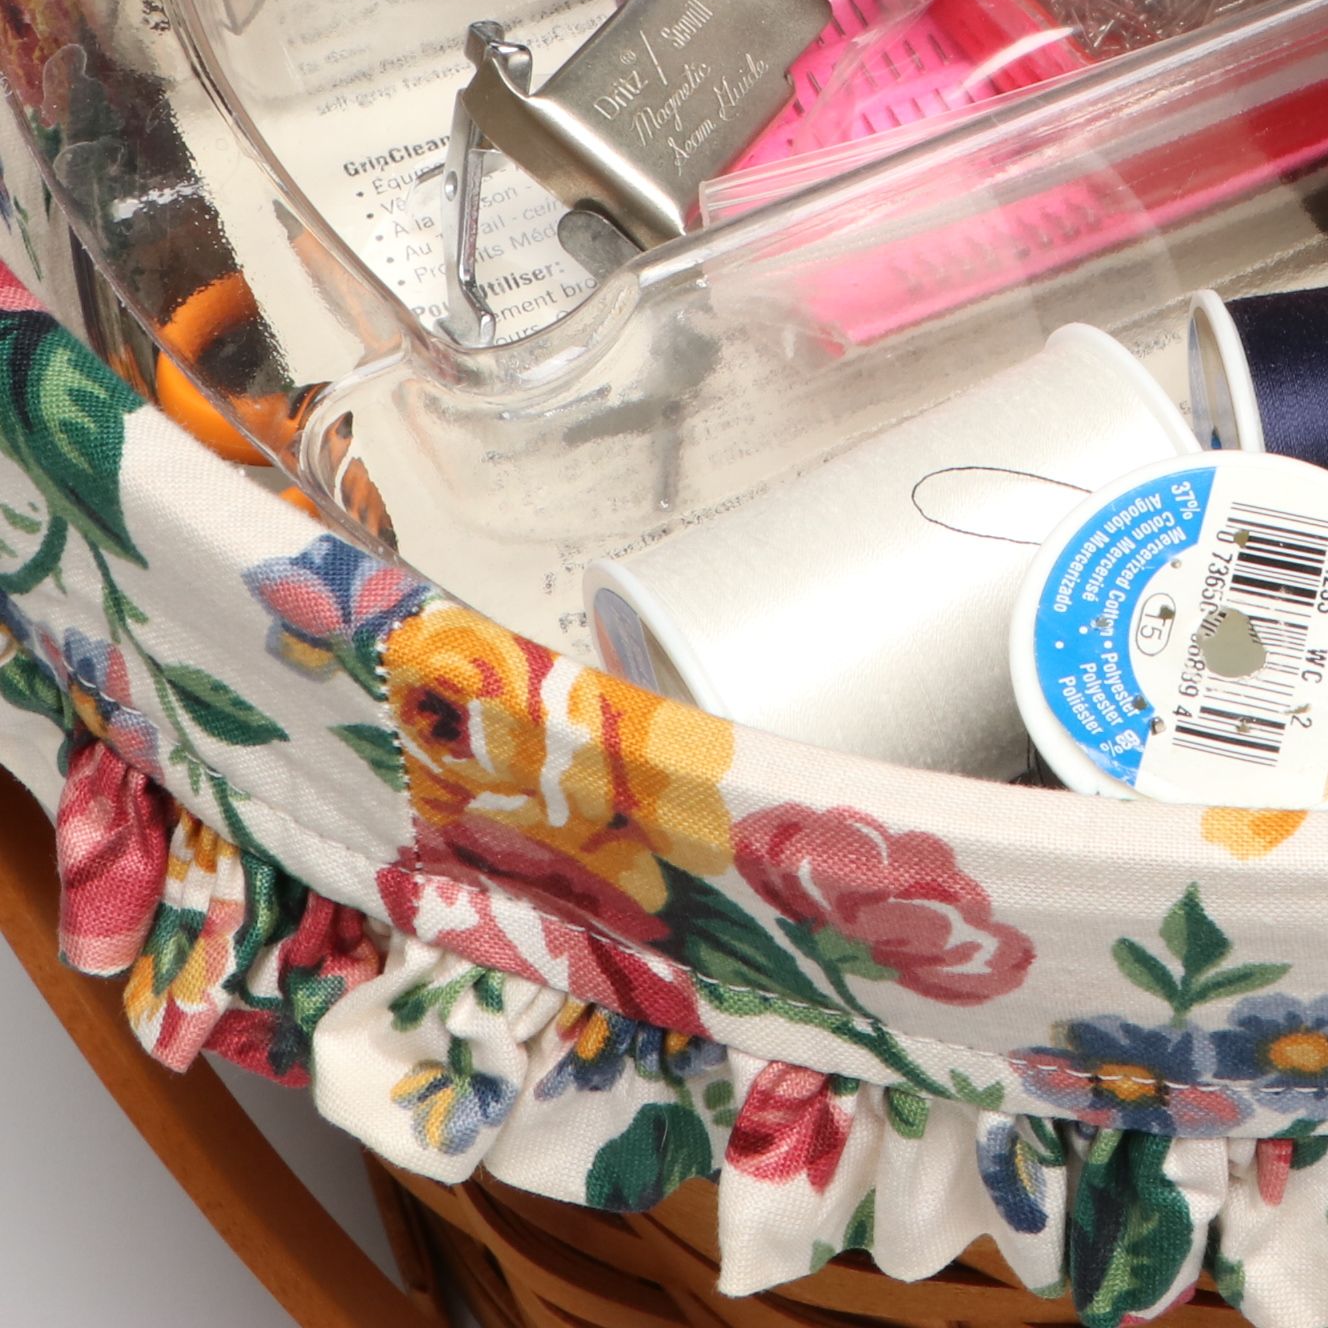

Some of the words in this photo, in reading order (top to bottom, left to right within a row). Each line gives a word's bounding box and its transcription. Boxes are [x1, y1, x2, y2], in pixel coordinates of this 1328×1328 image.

[593, 70, 649, 120] Dritz
[630, 63, 711, 146] Magnetic
[667, 118, 717, 177] Seam
[713, 52, 769, 121] Guide
[415, 215, 435, 231] la
[406, 242, 433, 262] Au
[1103, 492, 1163, 535] Algodón
[1130, 510, 1176, 542] Coton
[1170, 480, 1201, 521] 37%
[1053, 530, 1111, 613] Mercerizado
[1082, 535, 1137, 603] Mercerisé
[1115, 525, 1188, 591] Mercerized
[1058, 675, 1105, 737] Poliéster
[1079, 661, 1124, 727] Polyester
[1100, 652, 1141, 718] Polyester
[1172, 704, 1193, 719] 4
[1290, 713, 1313, 729] 2
